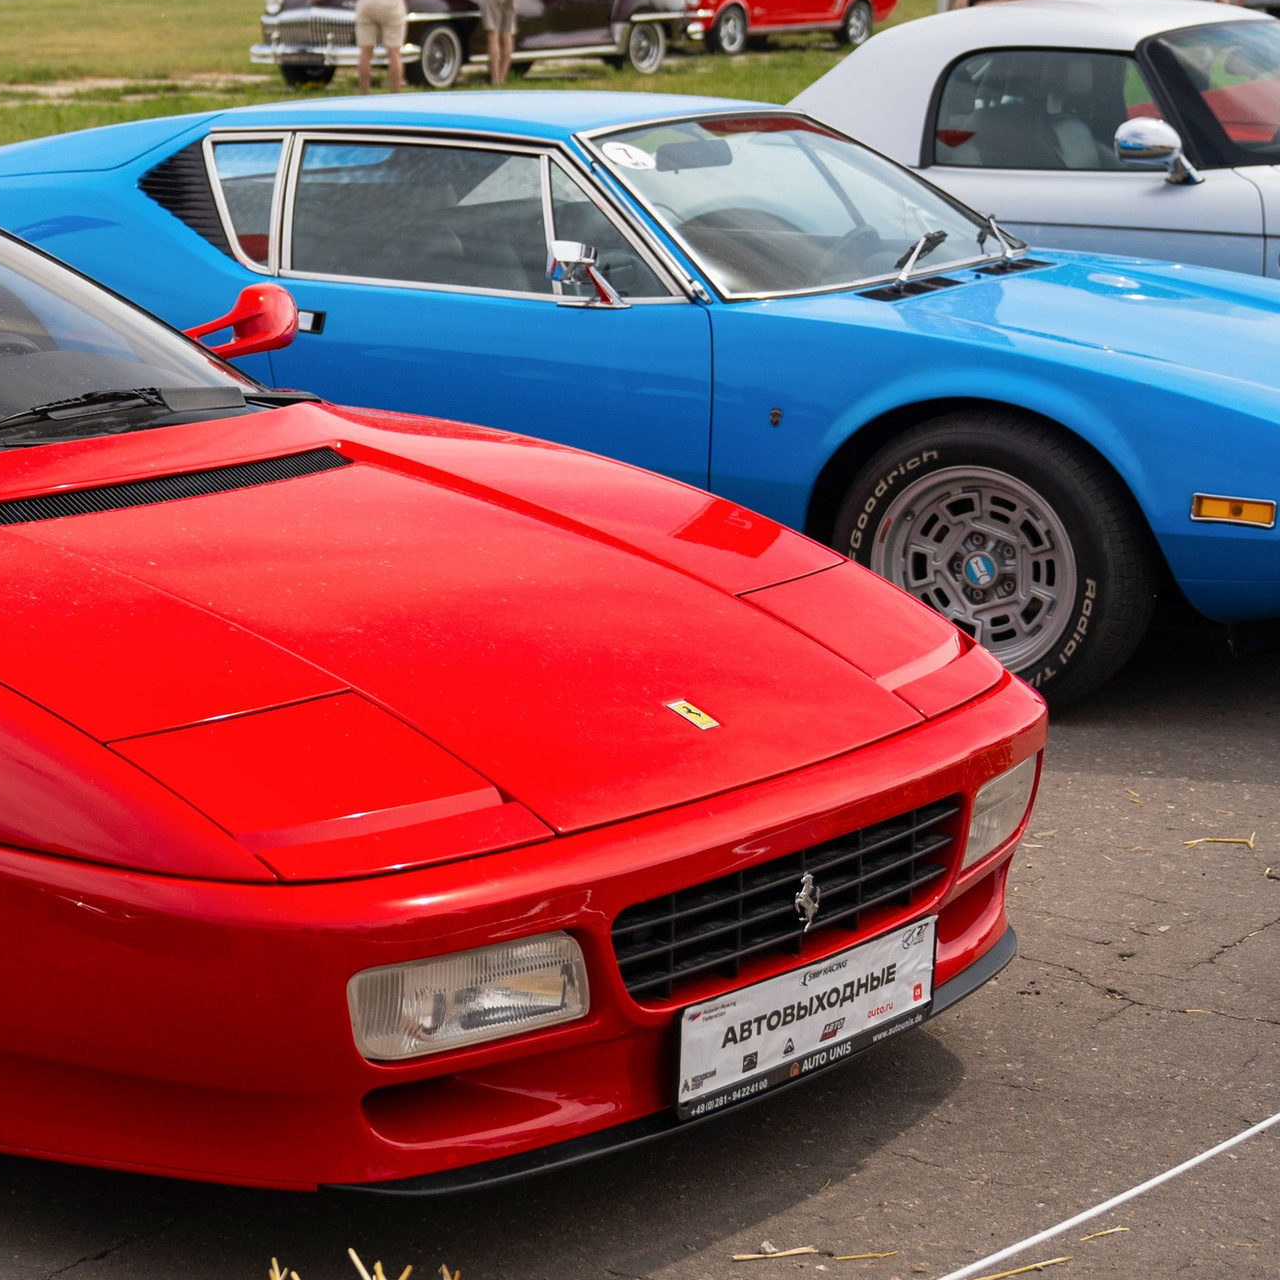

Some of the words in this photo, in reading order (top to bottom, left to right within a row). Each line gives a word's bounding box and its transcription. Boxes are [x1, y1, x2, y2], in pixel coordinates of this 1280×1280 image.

[848, 450, 938, 560] Goodrich
[1059, 578, 1096, 665] Radial
[721, 963, 897, 1049] АВТОВЫХОДНЫЕ
[867, 1002, 894, 1018] auto.ru
[801, 1051, 827, 1072] AUTO
[829, 1041, 852, 1060] UNIS
